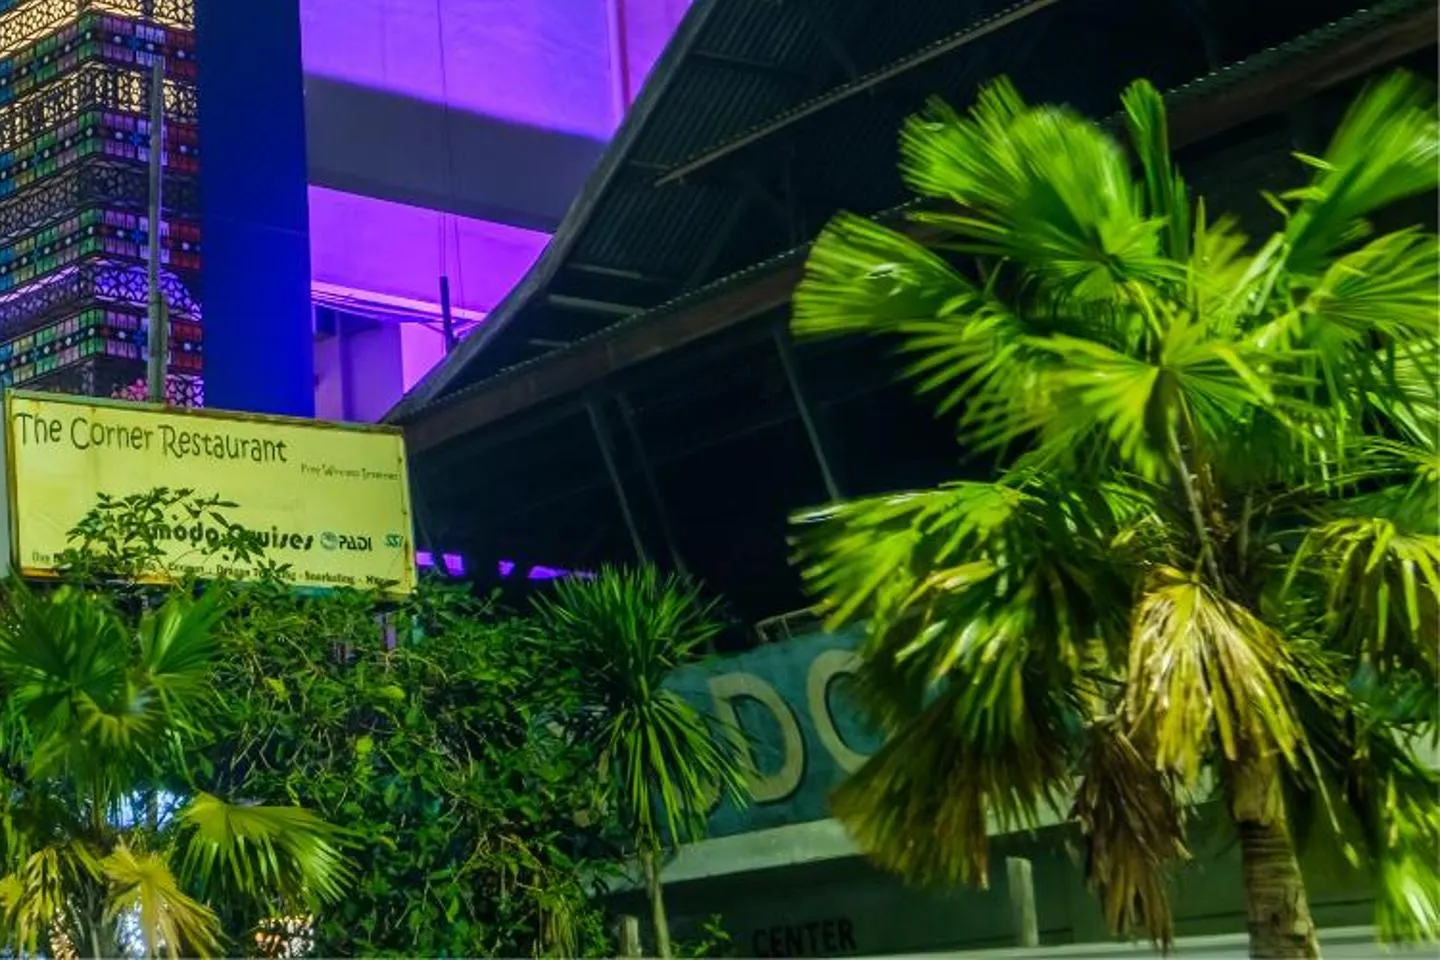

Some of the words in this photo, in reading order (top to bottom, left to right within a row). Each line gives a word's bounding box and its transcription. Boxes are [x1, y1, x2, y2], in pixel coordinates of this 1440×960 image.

[14, 413, 62, 445] The
[70, 417, 153, 450] Corner
[158, 425, 288, 463] Restaurant
[124, 518, 220, 545] modo
[339, 534, 372, 551] PADI
[752, 917, 857, 957] CENTER
